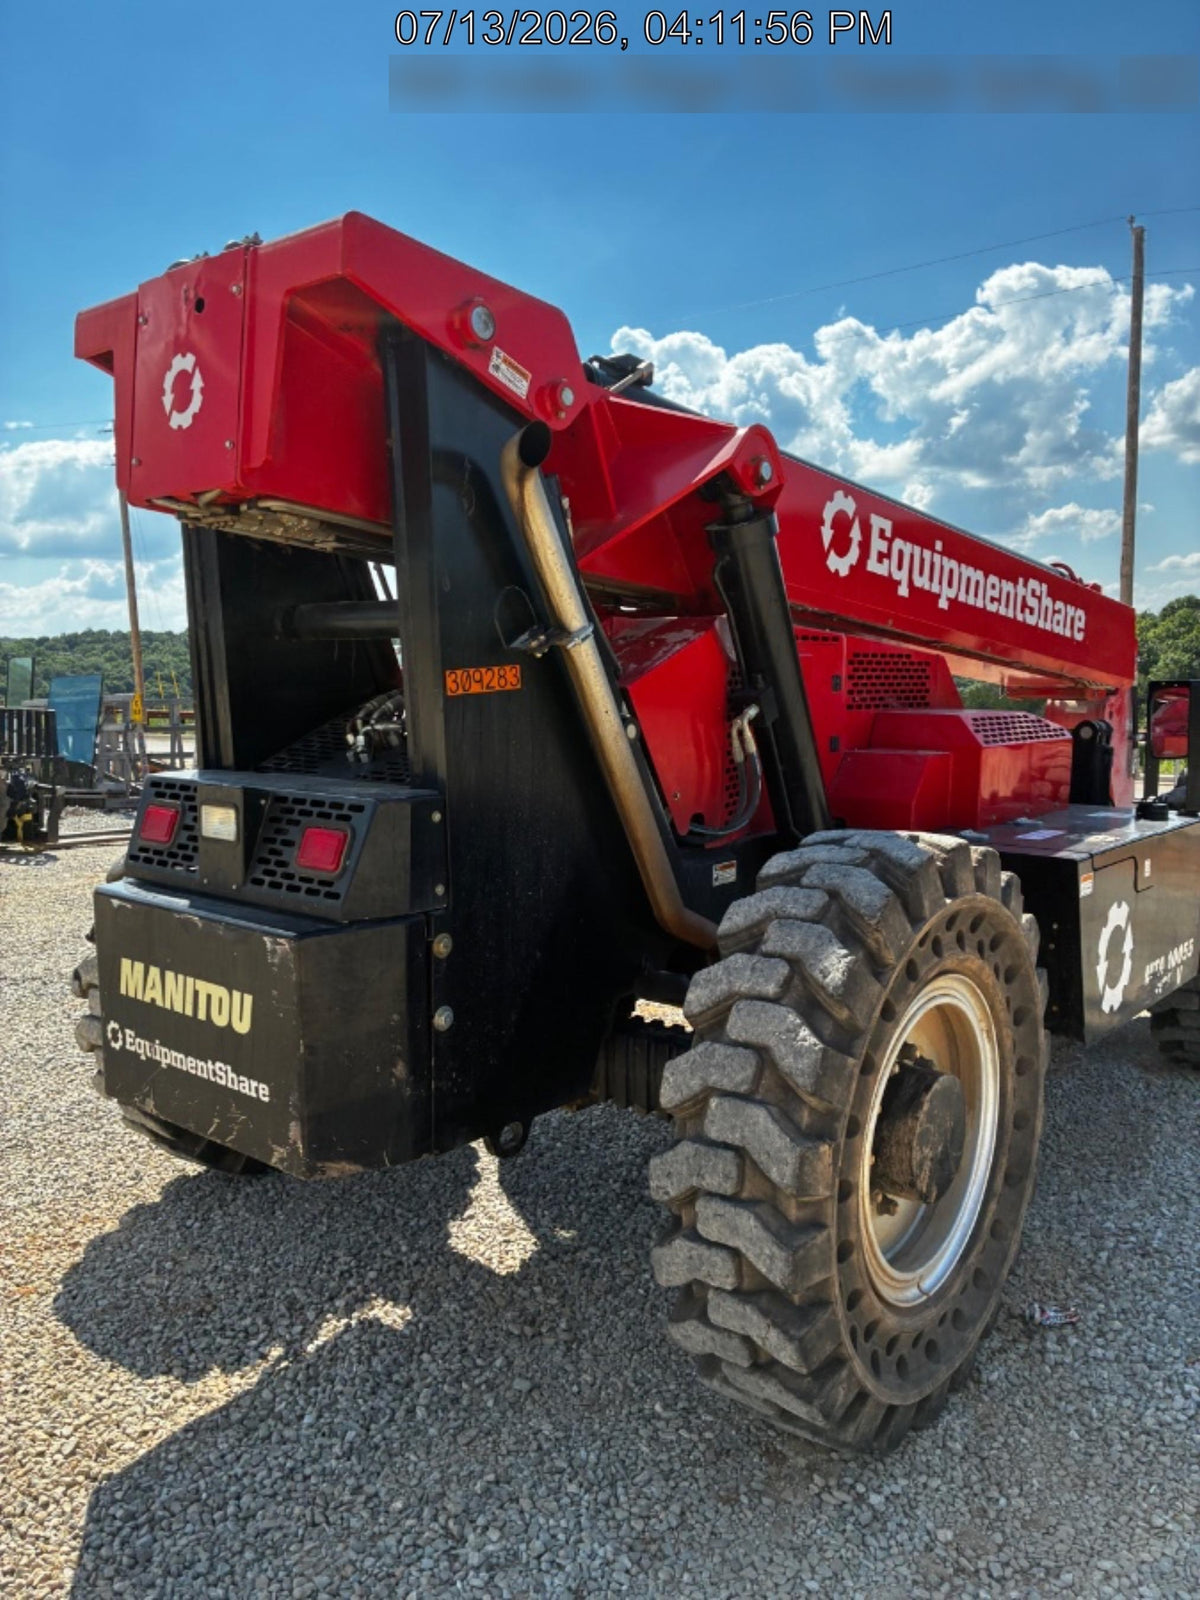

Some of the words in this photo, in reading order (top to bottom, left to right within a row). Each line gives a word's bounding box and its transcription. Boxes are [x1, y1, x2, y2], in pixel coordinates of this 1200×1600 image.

[866, 513, 1086, 642] EquipmentShare
[447, 665, 520, 694] 309283
[120, 957, 253, 1035] MANITOU
[125, 1028, 271, 1103] EquipmentShare
